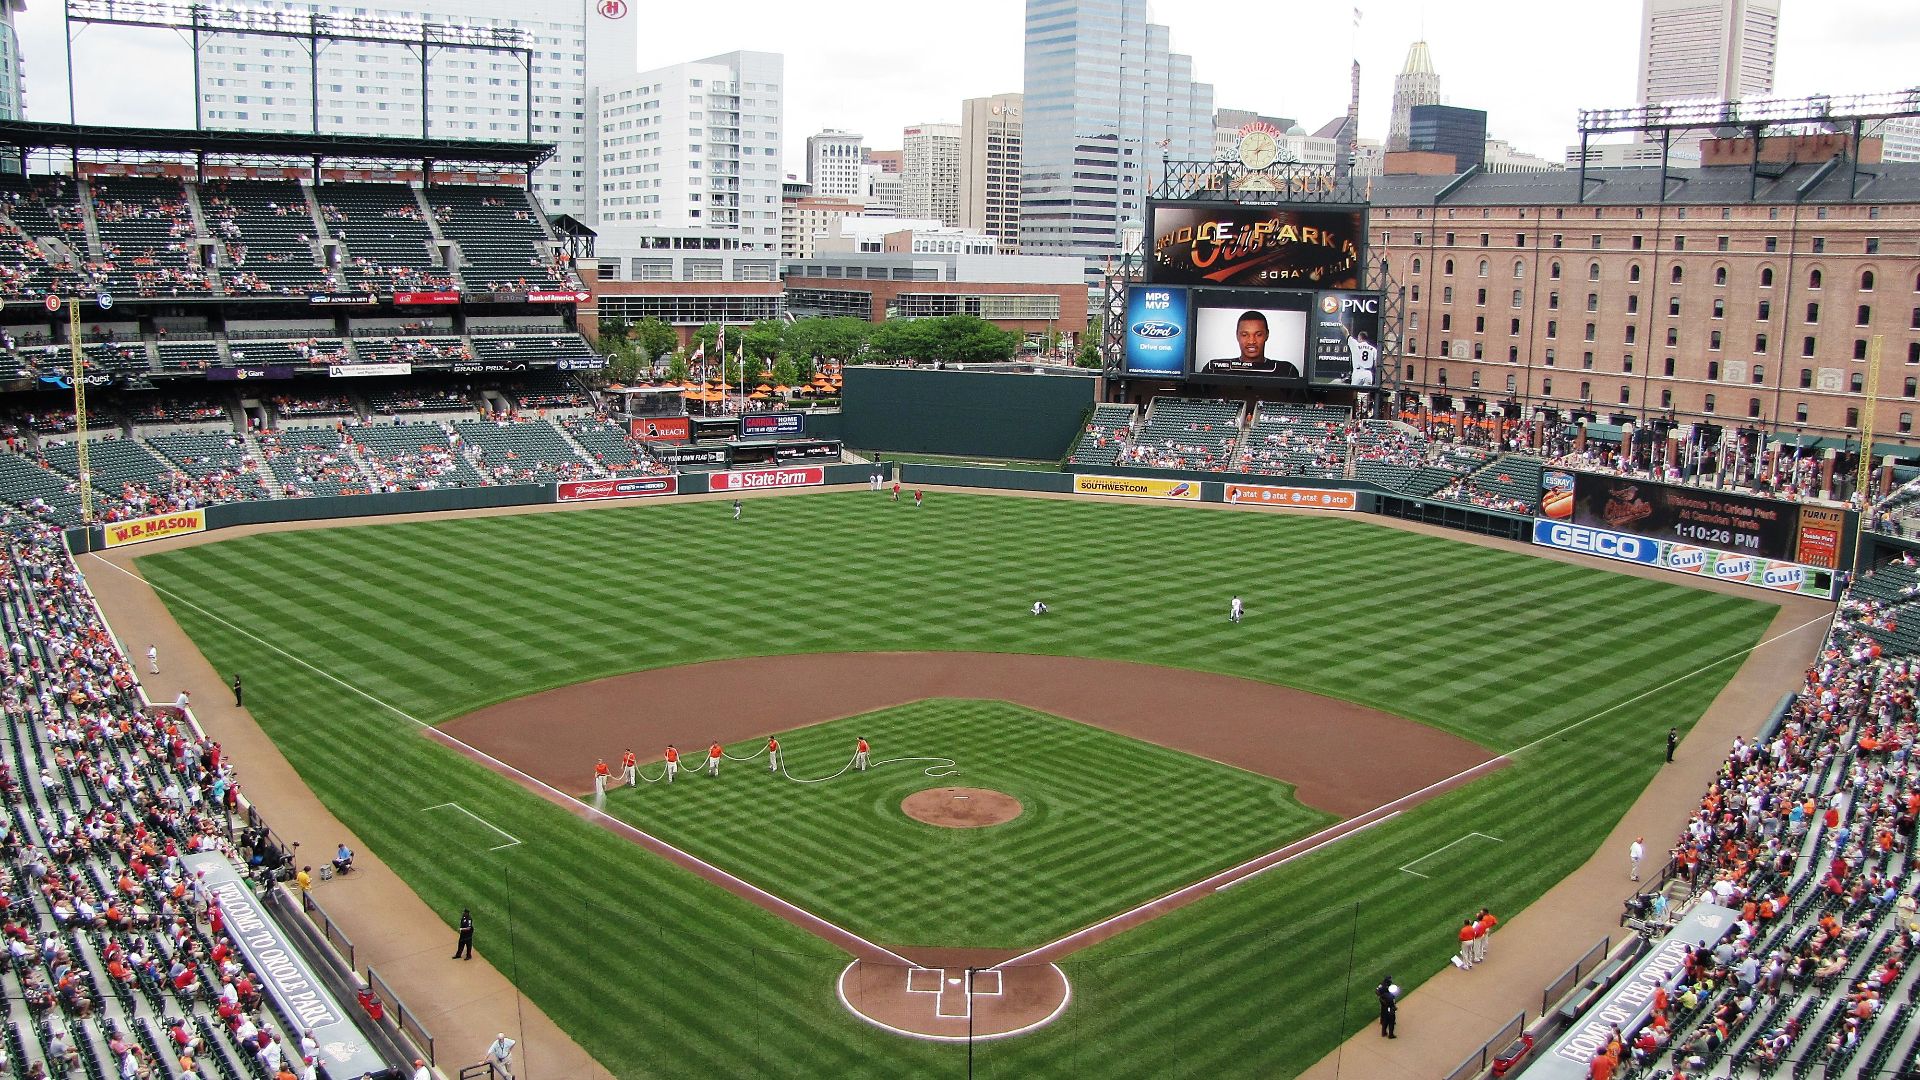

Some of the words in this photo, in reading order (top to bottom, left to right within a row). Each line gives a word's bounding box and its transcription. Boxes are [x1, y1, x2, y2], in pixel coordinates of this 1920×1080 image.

[1001, 106, 1018, 116] PNC
[1182, 172, 1224, 191] THE
[1291, 174, 1336, 193] SUN
[1254, 222, 1336, 249] PARK
[101, 296, 112, 306] 42
[1145, 292, 1170, 301] MPG
[1145, 301, 1170, 310] MVP
[1341, 299, 1378, 314] PNC
[1140, 322, 1172, 337] Ford
[1139, 343, 1157, 351] Drive
[1361, 350, 1369, 362] 8
[331, 367, 343, 376] UA
[660, 428, 685, 436] REACH
[1081, 482, 1148, 493] SOUTHWEST.COM
[1545, 476, 1572, 487] ESSKAY
[575, 485, 613, 494] Budweiser
[1242, 490, 1258, 498] at&t
[1271, 492, 1287, 500] at&t
[1301, 494, 1318, 502] at&t
[1331, 496, 1348, 504] at&t
[1710, 501, 1722, 512] To
[1754, 507, 1778, 521] Park
[1803, 509, 1827, 520] TURN
[1829, 513, 1840, 522] IT.
[145, 517, 198, 533] MASON
[1731, 516, 1760, 531] Yards
[1551, 524, 1640, 559] GEICO
[1673, 523, 1730, 544] 1:10:26
[1734, 532, 1760, 549] PM
[1670, 552, 1703, 566] Gulf
[1716, 560, 1751, 575] Gulf
[1764, 569, 1801, 584] Gulf
[217, 882, 266, 933] WELCOME
[246, 930, 277, 949] TO
[1638, 940, 1688, 984] ORIOLES
[259, 948, 310, 993] ORIOLE
[1614, 981, 1655, 1007] THE
[288, 989, 335, 1028] PARK
[1598, 1004, 1632, 1024] OF
[1559, 1021, 1612, 1061] HOME
